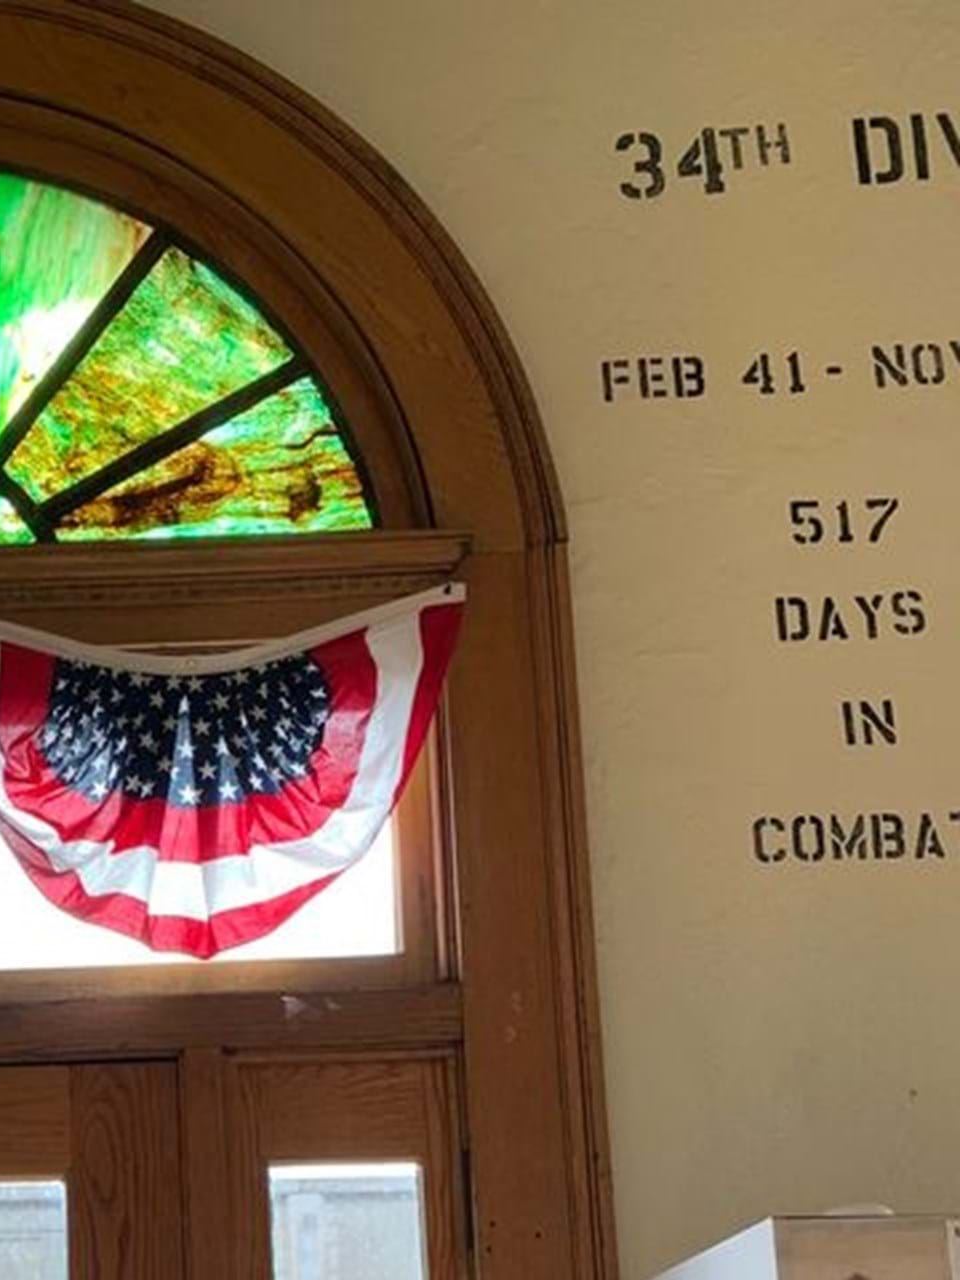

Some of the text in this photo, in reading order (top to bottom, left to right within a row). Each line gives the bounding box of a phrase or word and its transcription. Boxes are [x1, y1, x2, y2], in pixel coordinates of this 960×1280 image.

[614, 123, 791, 199] 34TH
[601, 355, 706, 402] FEB
[870, 340, 960, 389] NO
[789, 497, 899, 544] 517
[774, 589, 927, 642] DAYS
[841, 698, 897, 746] IN
